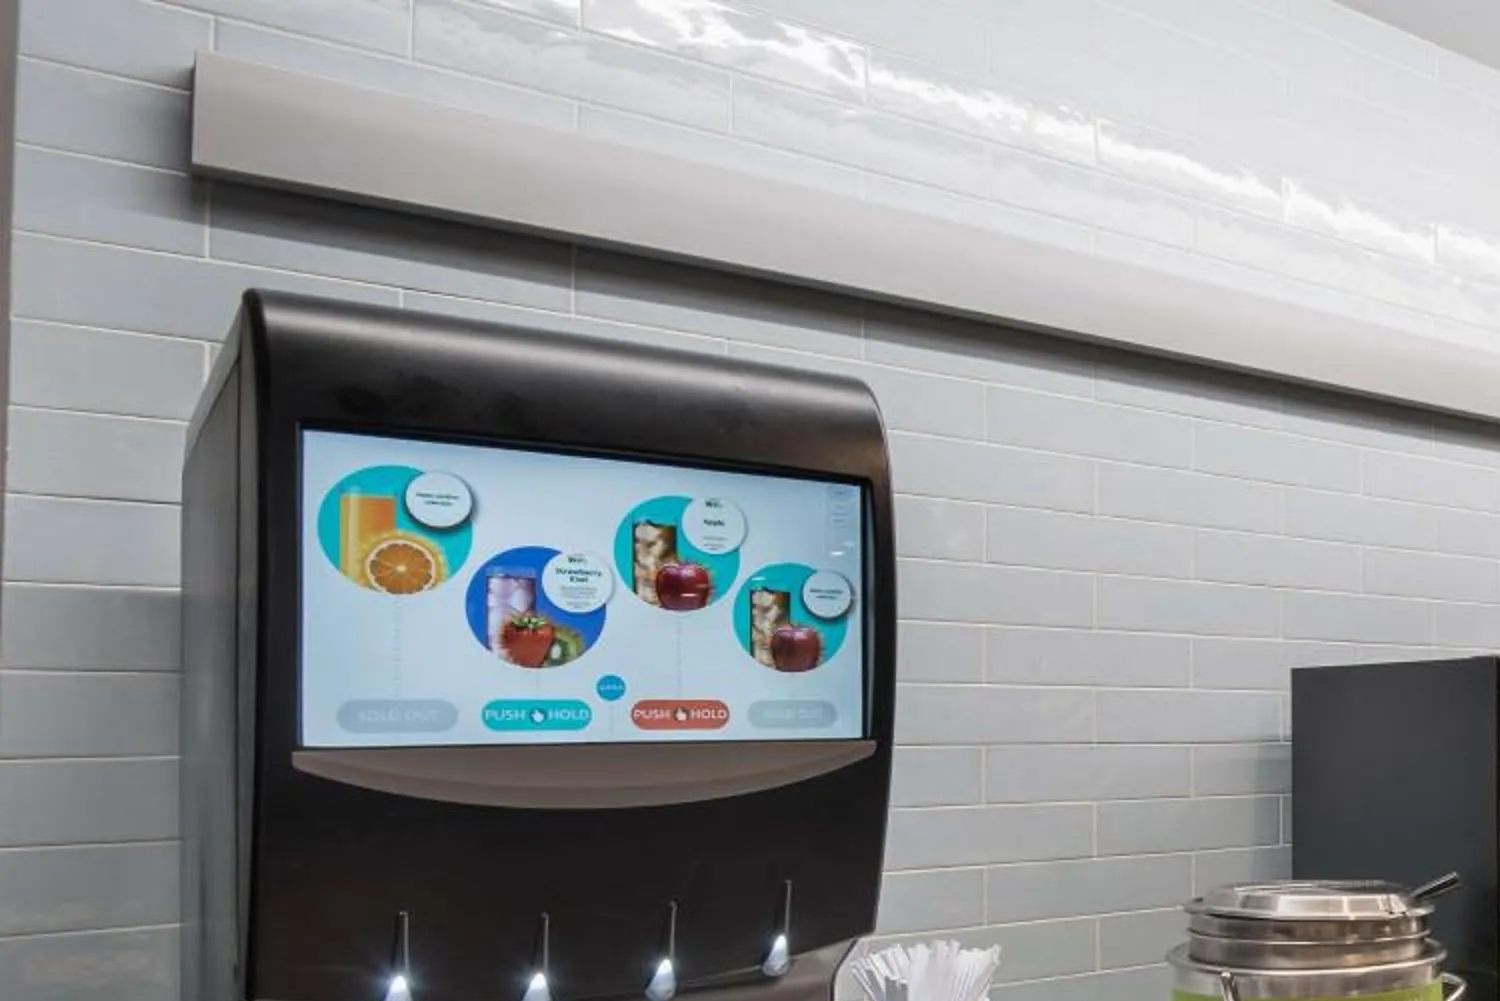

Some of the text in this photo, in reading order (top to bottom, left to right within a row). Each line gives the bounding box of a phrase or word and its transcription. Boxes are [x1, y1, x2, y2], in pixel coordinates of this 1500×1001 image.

[485, 707, 590, 722] PUSH HOLD
[633, 709, 729, 721] PUSH HOLD
